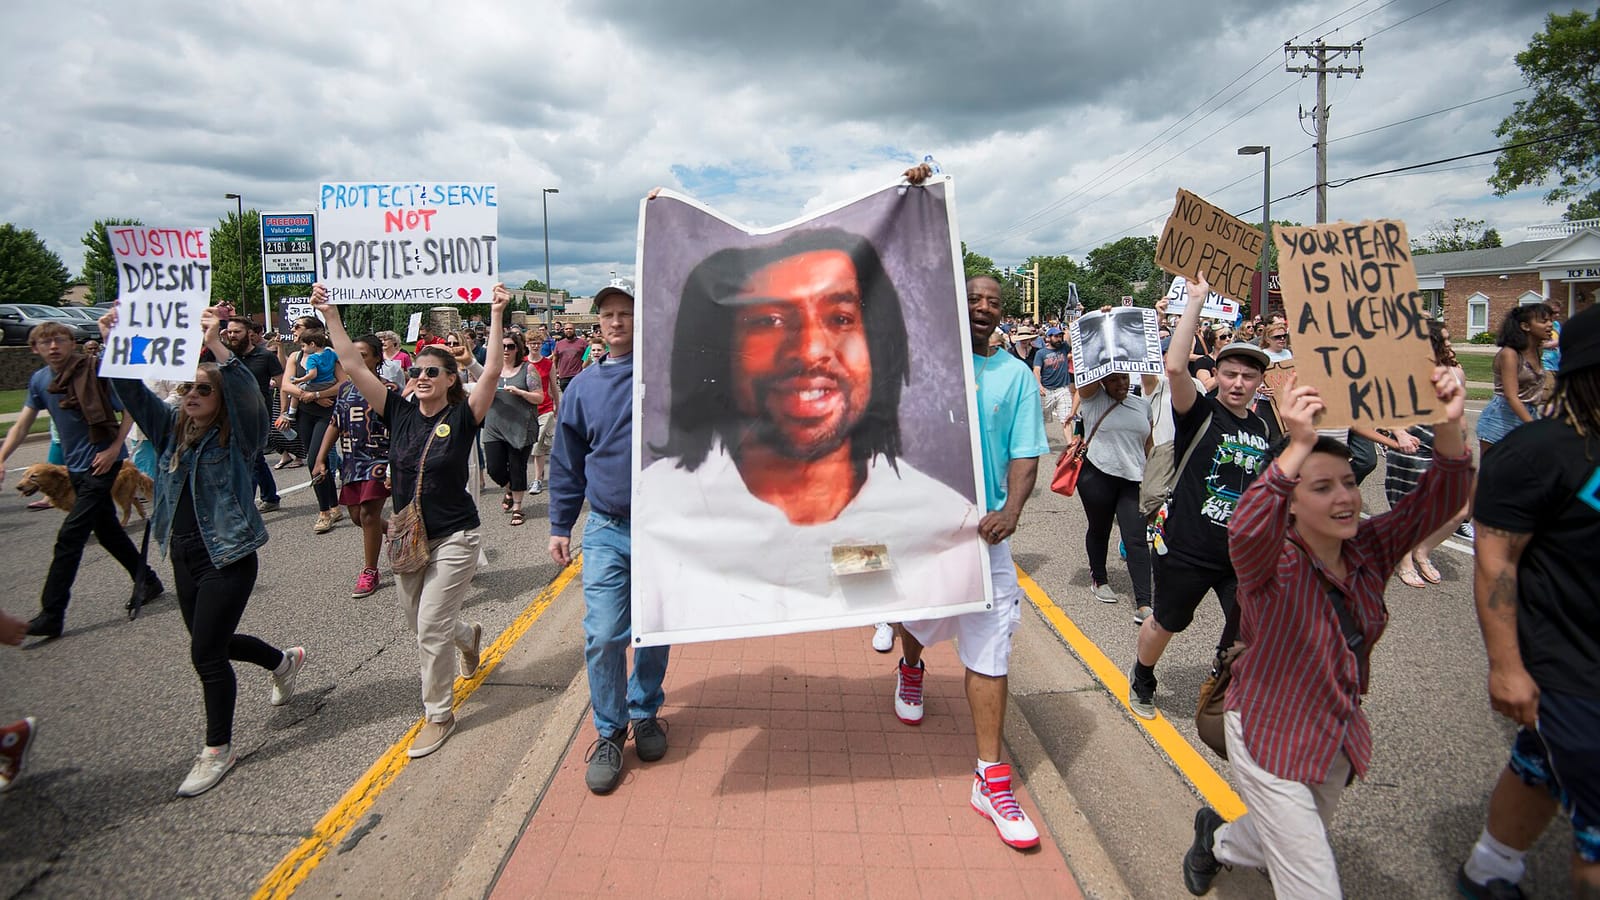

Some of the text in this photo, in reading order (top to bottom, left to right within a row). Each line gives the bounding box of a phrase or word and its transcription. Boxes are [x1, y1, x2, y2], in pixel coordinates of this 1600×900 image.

[321, 184, 420, 210] PROTECT
[429, 184, 498, 208] SERVE
[266, 217, 310, 226] FREEDOM
[385, 208, 437, 233] NOT
[1175, 194, 1262, 256] NO JUSTICE
[113, 228, 208, 259] JUSTICE
[320, 240, 414, 280] PROFILE
[423, 235, 497, 276] SHOOT
[1281, 223, 1408, 262] YOUR FEAR
[122, 260, 210, 293] DOESN'T
[271, 273, 311, 284] CAR WASH
[1159, 227, 1255, 301] NO PEACE
[1301, 260, 1400, 294] IS NOT
[1567, 269, 1584, 277] TCF
[128, 301, 189, 329] LIVE
[1298, 291, 1430, 340] A LICENSE
[111, 334, 187, 366] HRE
[1313, 345, 1367, 380] TO
[1121, 361, 1161, 373] WORLD
[1348, 374, 1434, 421] KILL
[1221, 433, 1238, 443] THE
[1201, 505, 1233, 522] RIF
[1206, 496, 1232, 510] LIVE
